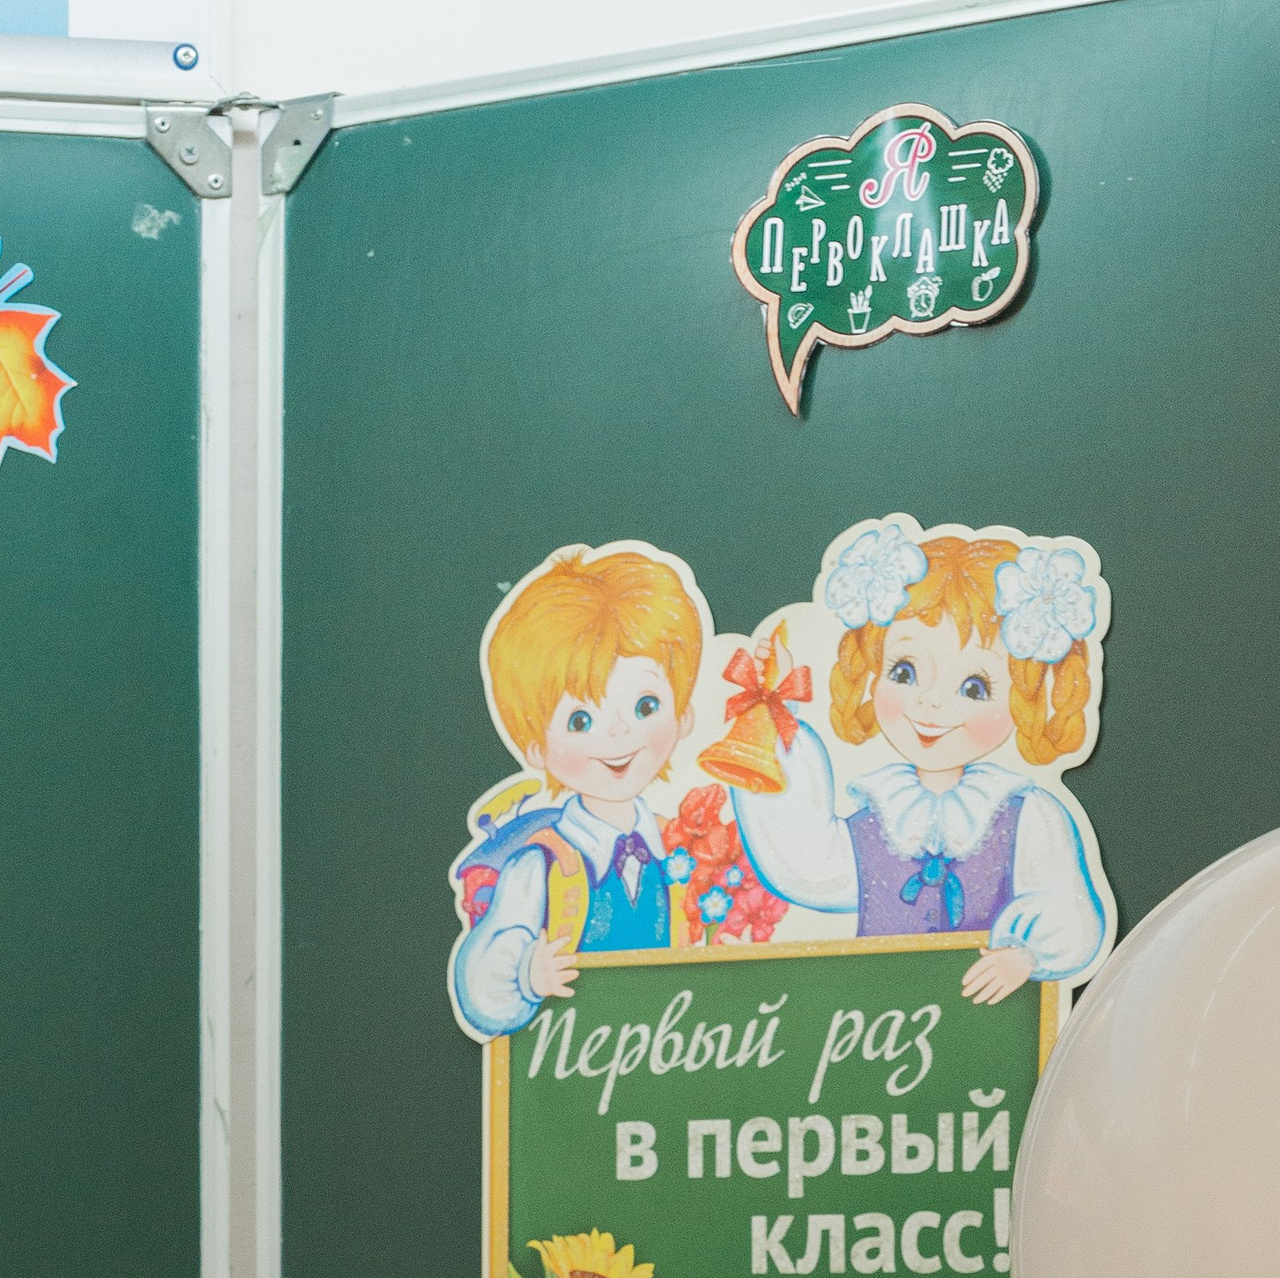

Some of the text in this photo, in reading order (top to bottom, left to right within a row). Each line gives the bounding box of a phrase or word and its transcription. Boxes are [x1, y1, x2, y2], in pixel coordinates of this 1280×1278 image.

[858, 121, 938, 209] Я
[760, 198, 1011, 293] ПЕРВОКЛАШКА
[527, 988, 943, 1116] Первый раз
[615, 1087, 1011, 1199] в первый
[749, 1187, 1012, 1275] класс!
